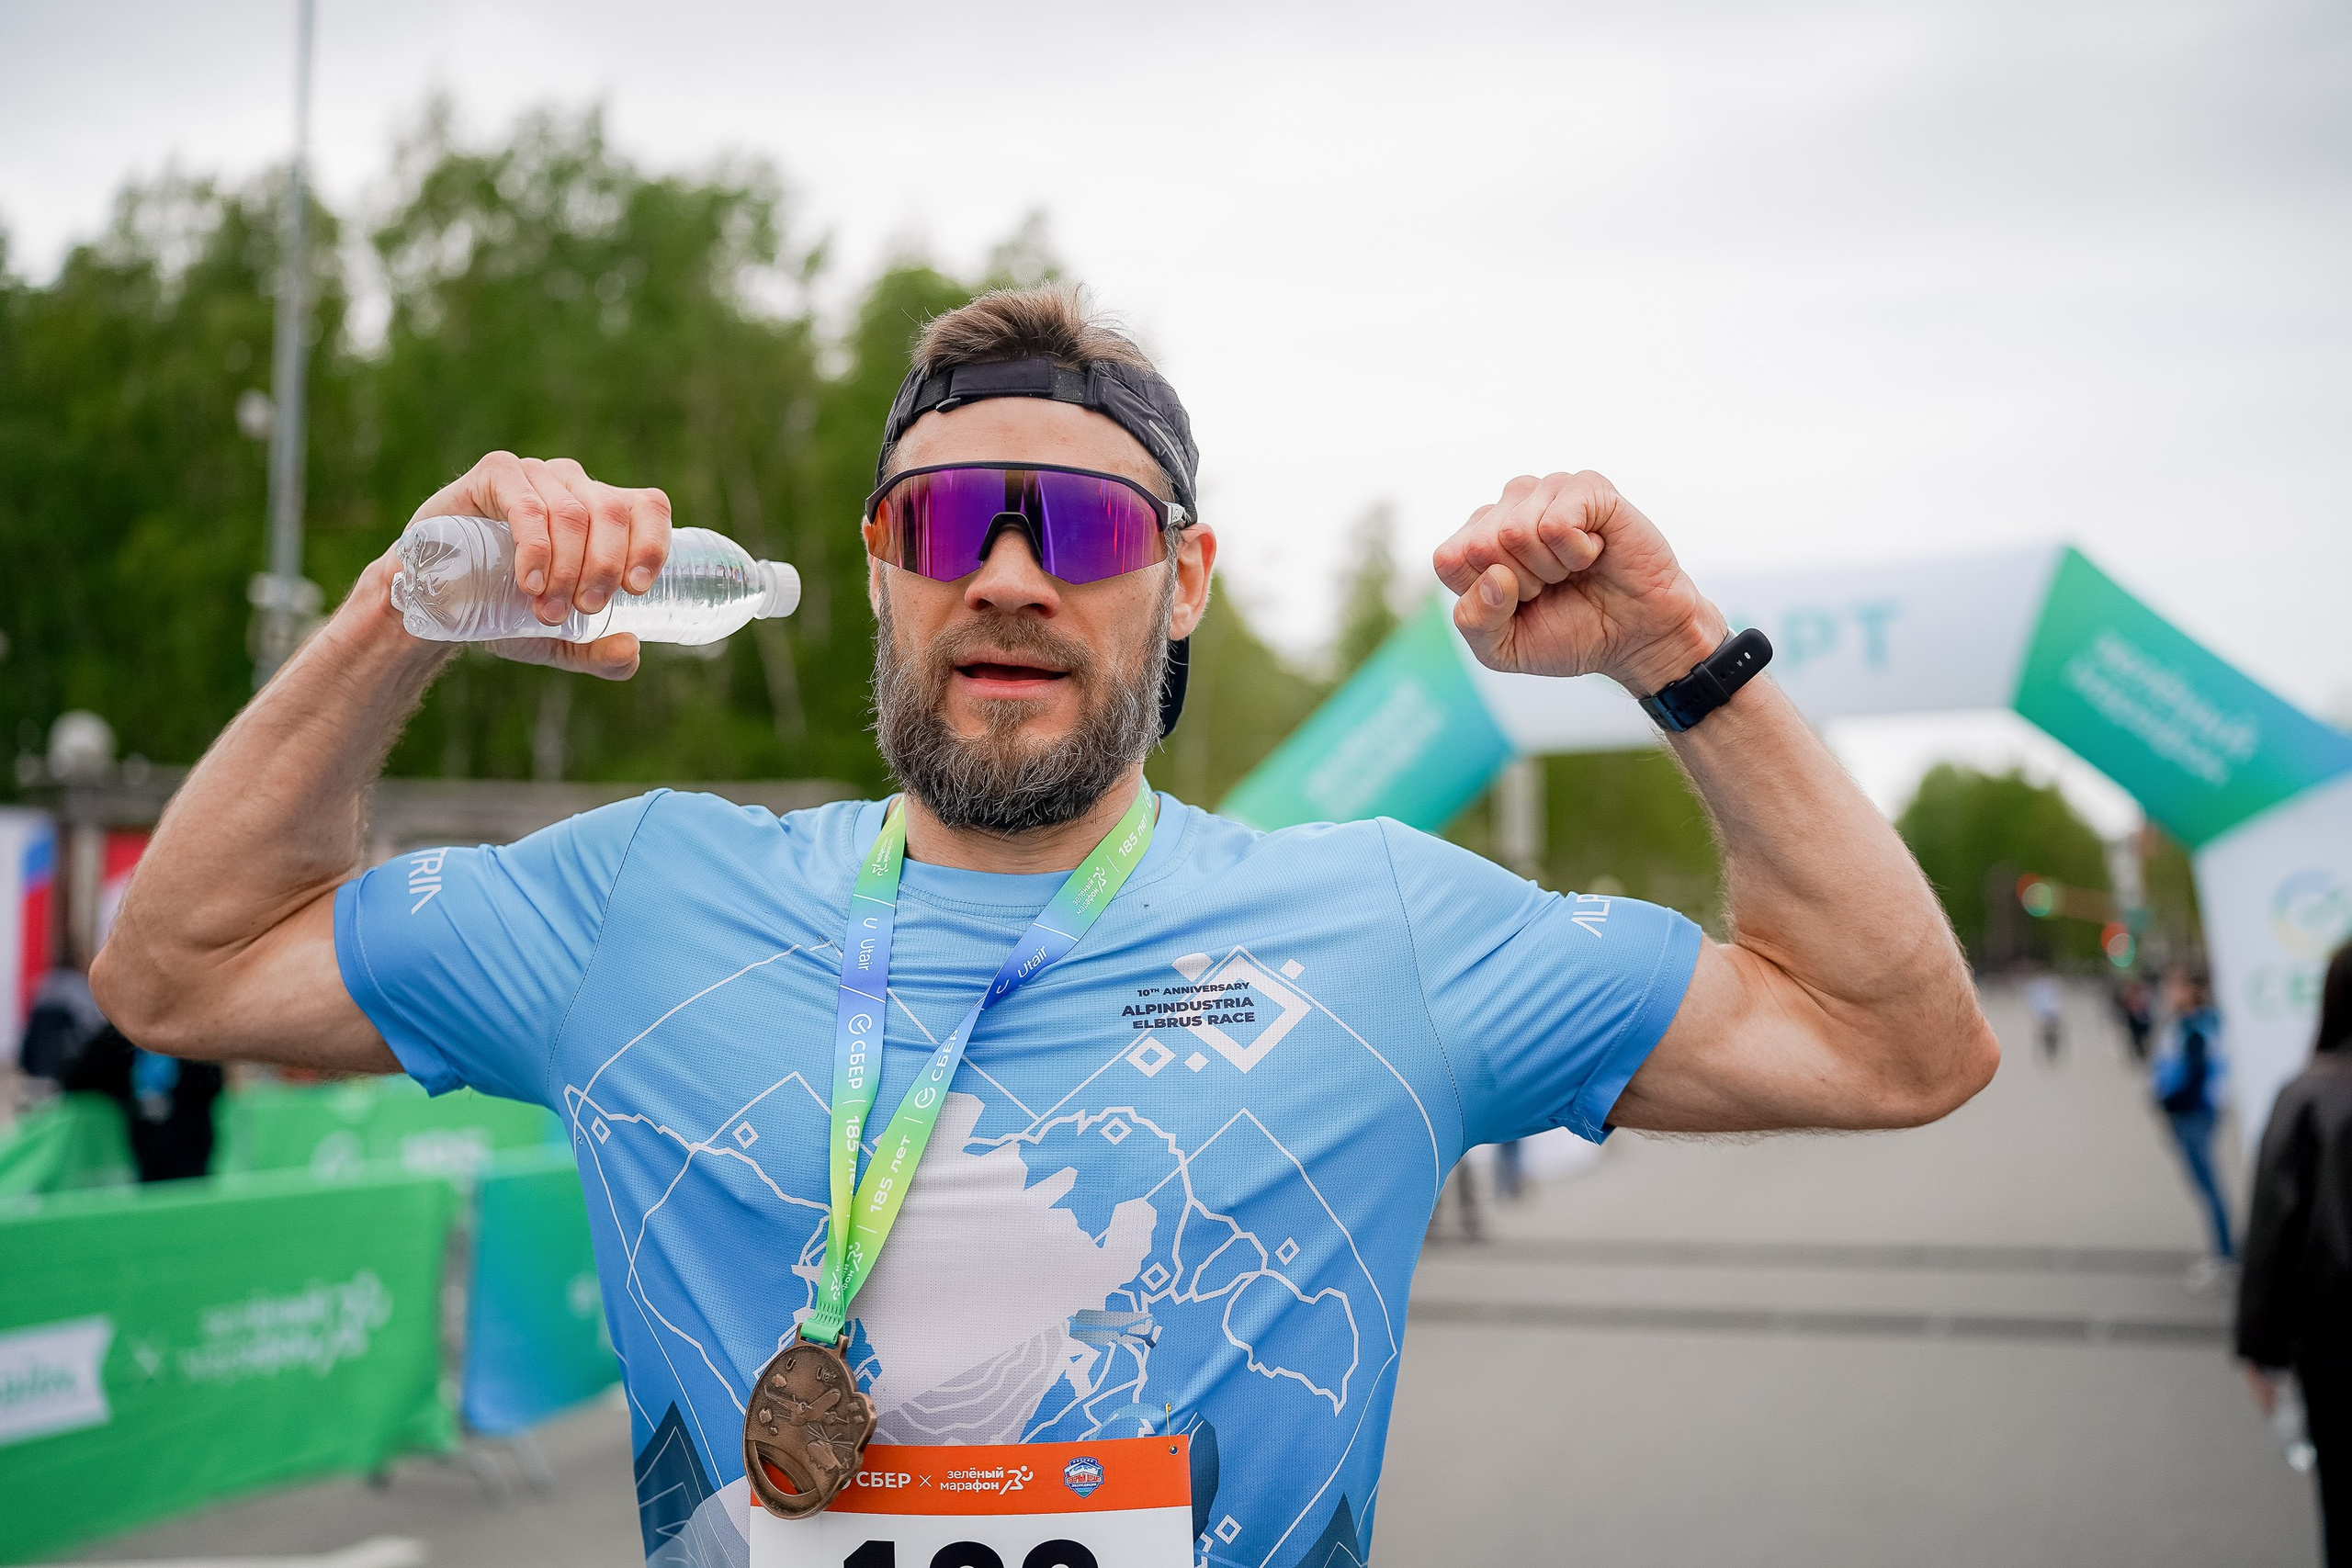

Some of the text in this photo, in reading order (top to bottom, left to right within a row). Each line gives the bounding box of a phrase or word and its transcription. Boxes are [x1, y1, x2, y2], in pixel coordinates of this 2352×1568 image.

[1118, 832, 1138, 857] 185
[1072, 876, 1094, 906] зелёный
[1077, 887, 1100, 916] марафон
[857, 938, 876, 971] Utair
[1017, 944, 1047, 978] Utair
[1162, 982, 1250, 996] ANNIVERSARY
[1121, 997, 1255, 1017] ALPINDUSTRIA
[1132, 1011, 1256, 1030] ELBRUS RACE
[847, 1040, 866, 1089] СБЕР
[931, 1029, 960, 1082] СБЕР
[846, 1115, 861, 1153] 185
[870, 1135, 911, 1213] 185 лет
[855, 1471, 911, 1489] СБЕР
[940, 1480, 1000, 1493] марафон
[946, 1467, 1004, 1479] зелёный
